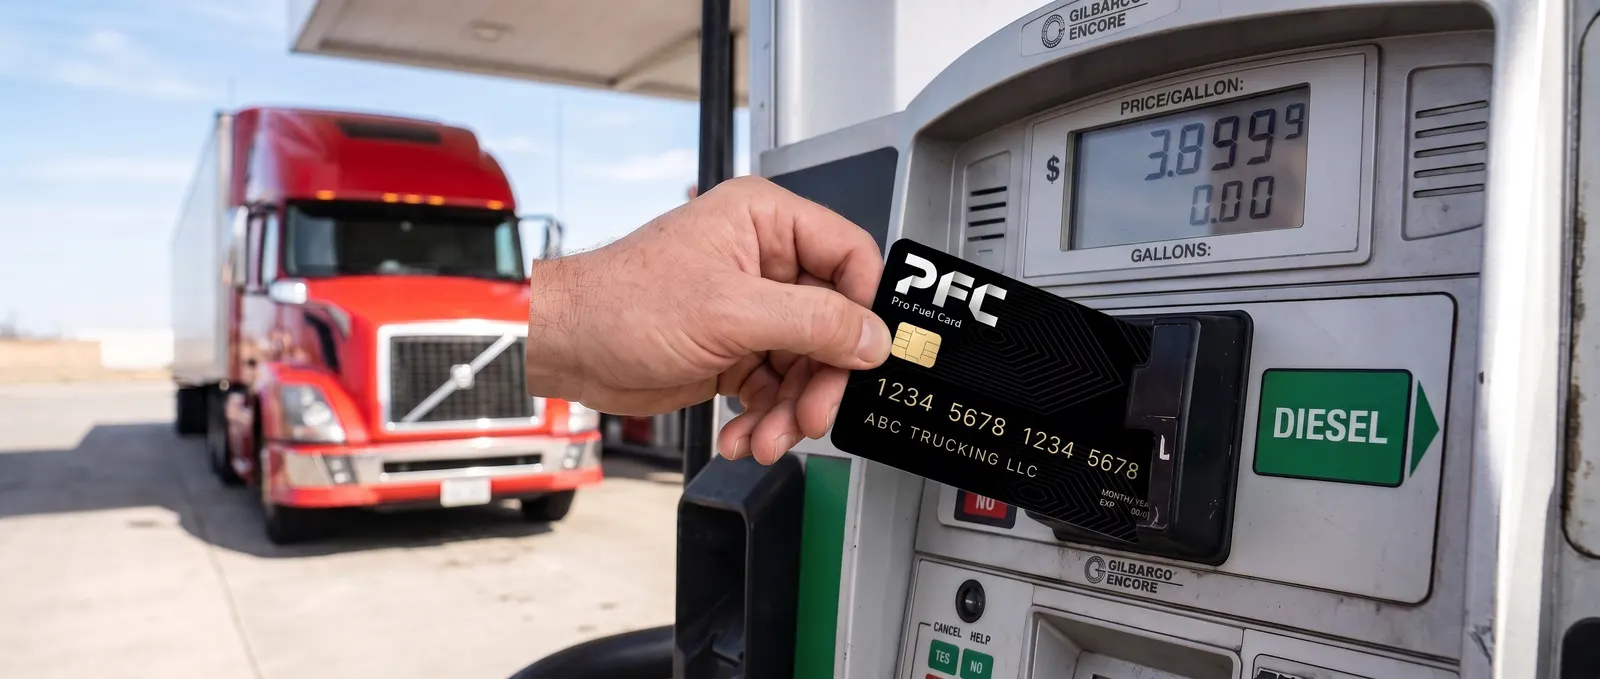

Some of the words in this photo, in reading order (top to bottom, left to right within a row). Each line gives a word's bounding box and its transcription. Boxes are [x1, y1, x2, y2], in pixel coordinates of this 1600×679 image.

[1069, 0, 1141, 22] GILBARC
[1069, 13, 1126, 40] ENCORE
[1120, 77, 1244, 116] PRICE/GALLON:
[1046, 155, 1060, 184] $
[1189, 175, 1275, 226] 0.00
[1130, 242, 1212, 263] GALLONS:
[894, 252, 1008, 328] PFC
[891, 296, 911, 310] Pro
[912, 303, 936, 320] Fuel
[937, 312, 963, 328] Card
[877, 378, 935, 412] 1234
[948, 402, 1007, 437] 5678
[1023, 427, 1075, 459] 1234
[1087, 448, 1140, 480] 5678
[1273, 407, 1388, 444] DIESEL
[864, 412, 902, 434] ABC
[910, 425, 999, 466] TRUCKING
[1006, 458, 1039, 478] LLC
[1099, 498, 1115, 508] EXP
[1106, 574, 1158, 594] ENCORE
[933, 621, 962, 638] CANCEL
[969, 631, 992, 645] HELP
[969, 660, 984, 674] NO
